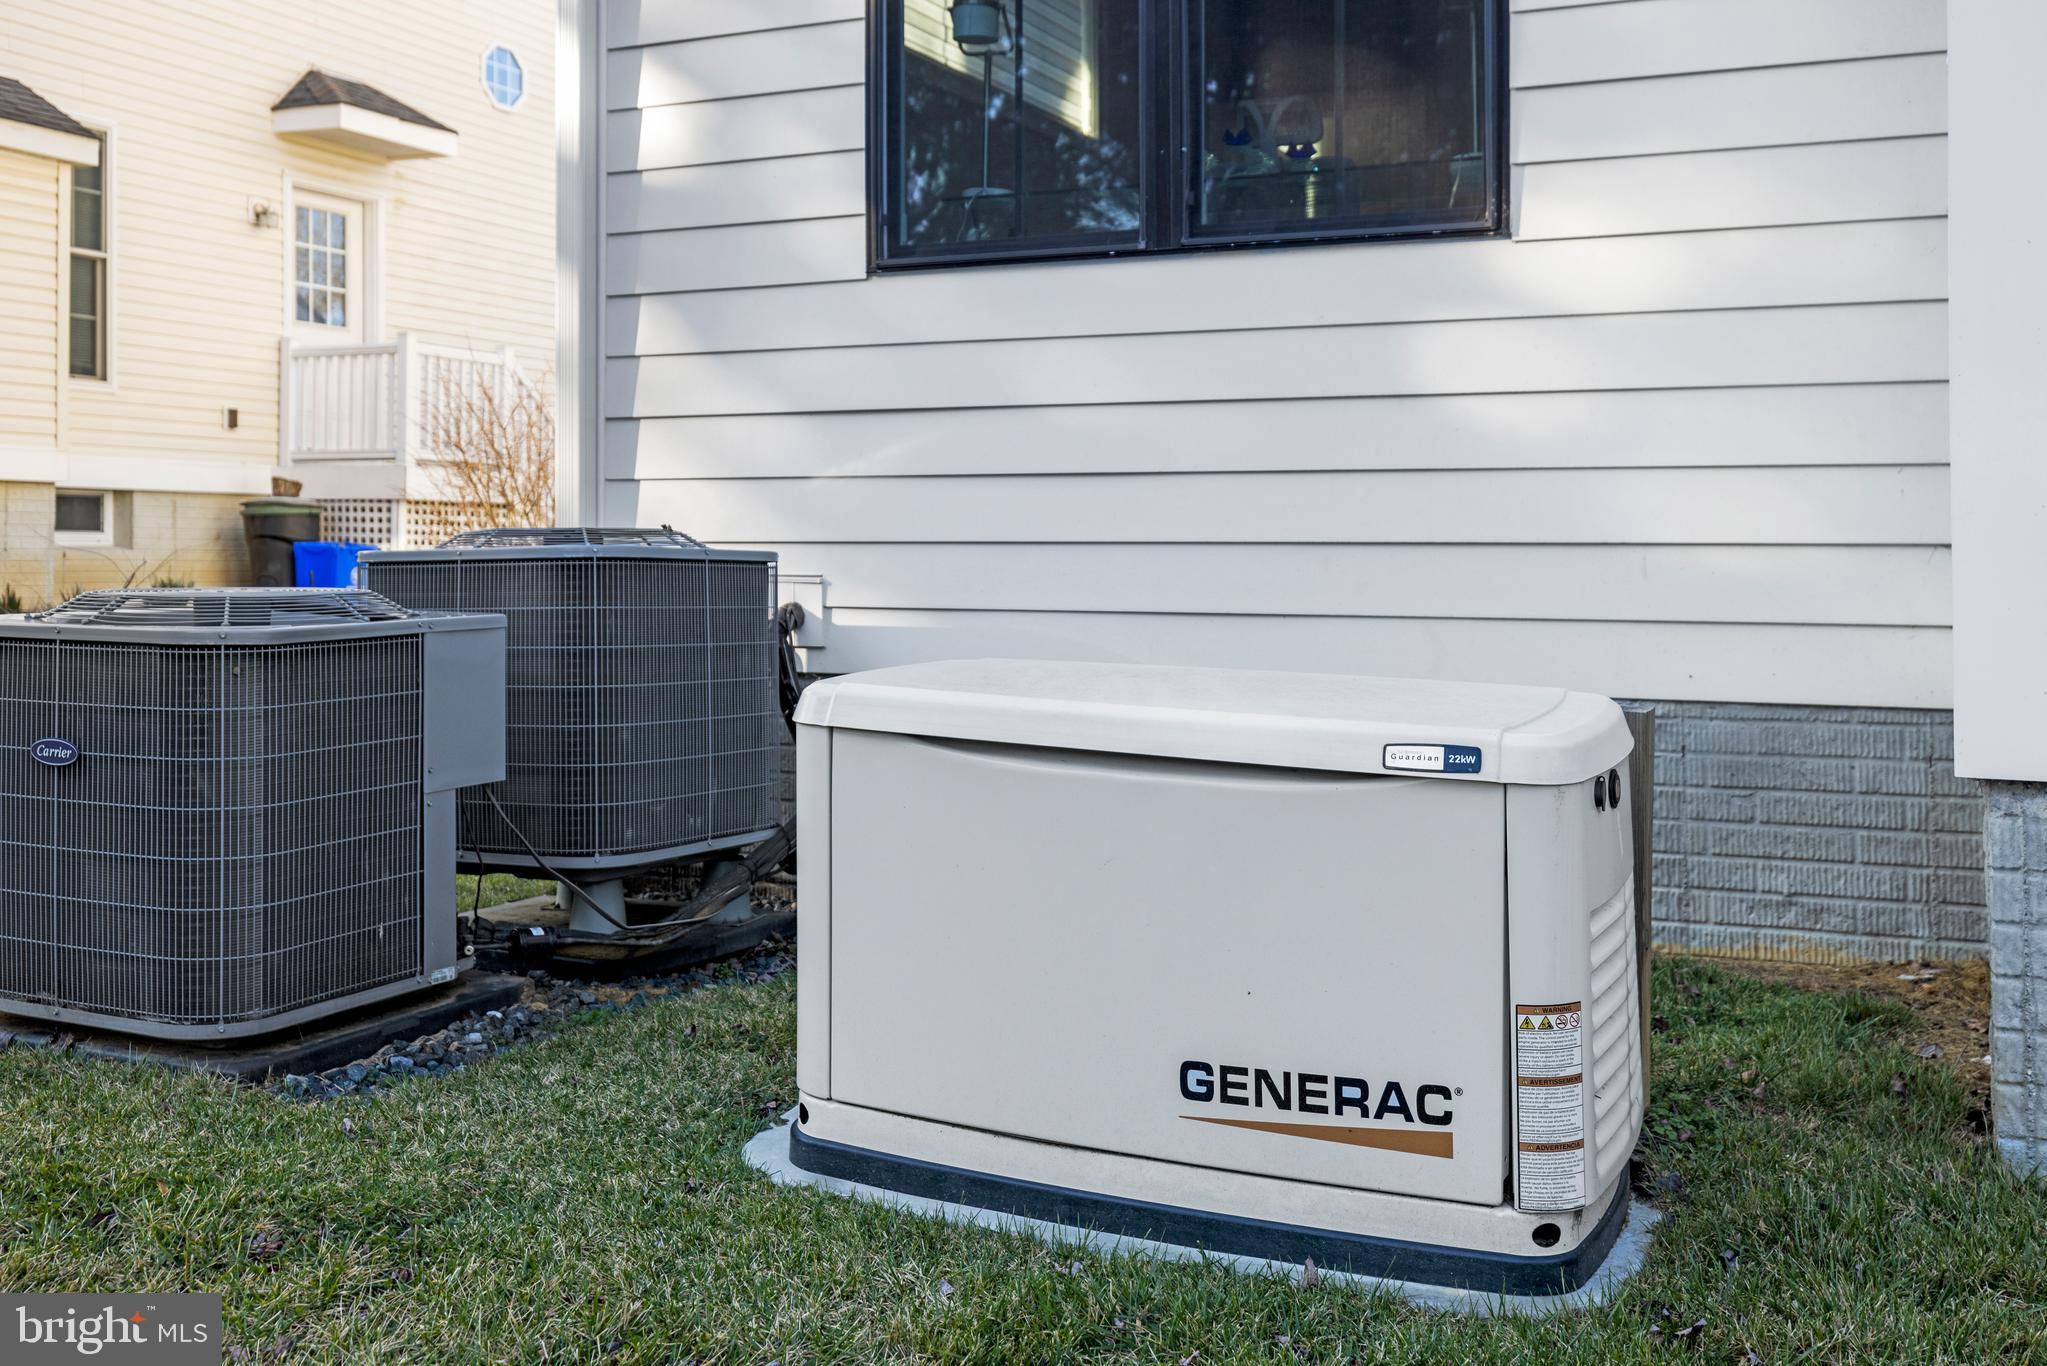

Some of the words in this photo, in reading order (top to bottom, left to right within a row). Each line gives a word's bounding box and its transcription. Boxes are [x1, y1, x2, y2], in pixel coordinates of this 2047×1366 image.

[36, 744, 72, 759] Carrier
[1390, 753, 1440, 762] Guardian
[1448, 754, 1476, 764] 22kW
[1541, 1005, 1572, 1014] WARNING
[1529, 1075, 1581, 1086] AVERTISSEMENT
[1179, 1060, 1453, 1126] GENERAC
[1535, 1141, 1581, 1151] ADVERTENCIA
